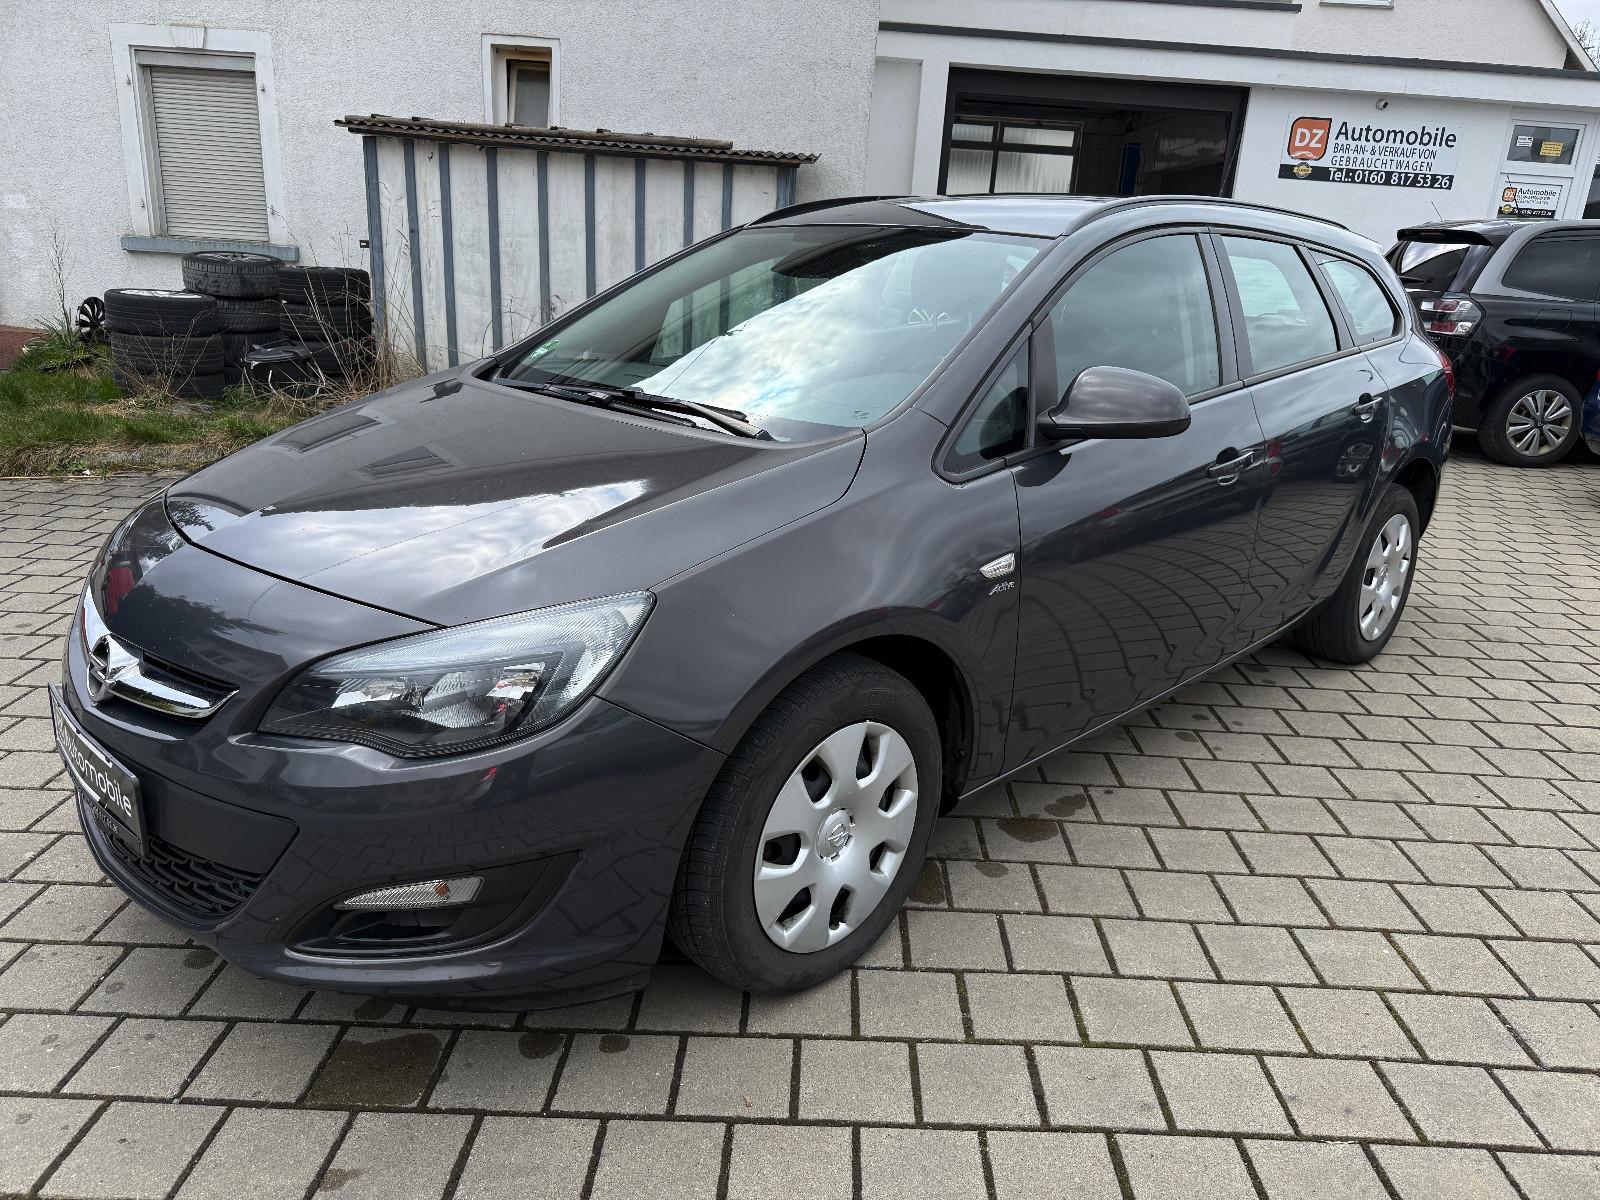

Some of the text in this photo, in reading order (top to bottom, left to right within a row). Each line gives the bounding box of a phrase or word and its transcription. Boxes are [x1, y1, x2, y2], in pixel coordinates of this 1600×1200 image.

[1294, 127, 1325, 148] DZ
[1334, 121, 1457, 148] Automobile
[1333, 142, 1438, 160] BAR-AN- & VERKAUF VON
[1330, 155, 1433, 172] GEBRAUCHTWAGEN
[1328, 167, 1353, 182] Tel.:
[1354, 170, 1386, 184] 0160
[1390, 172, 1415, 186] 817
[1415, 174, 1432, 187] 53
[1433, 175, 1450, 189] 26
[1517, 187, 1557, 197] Automobile
